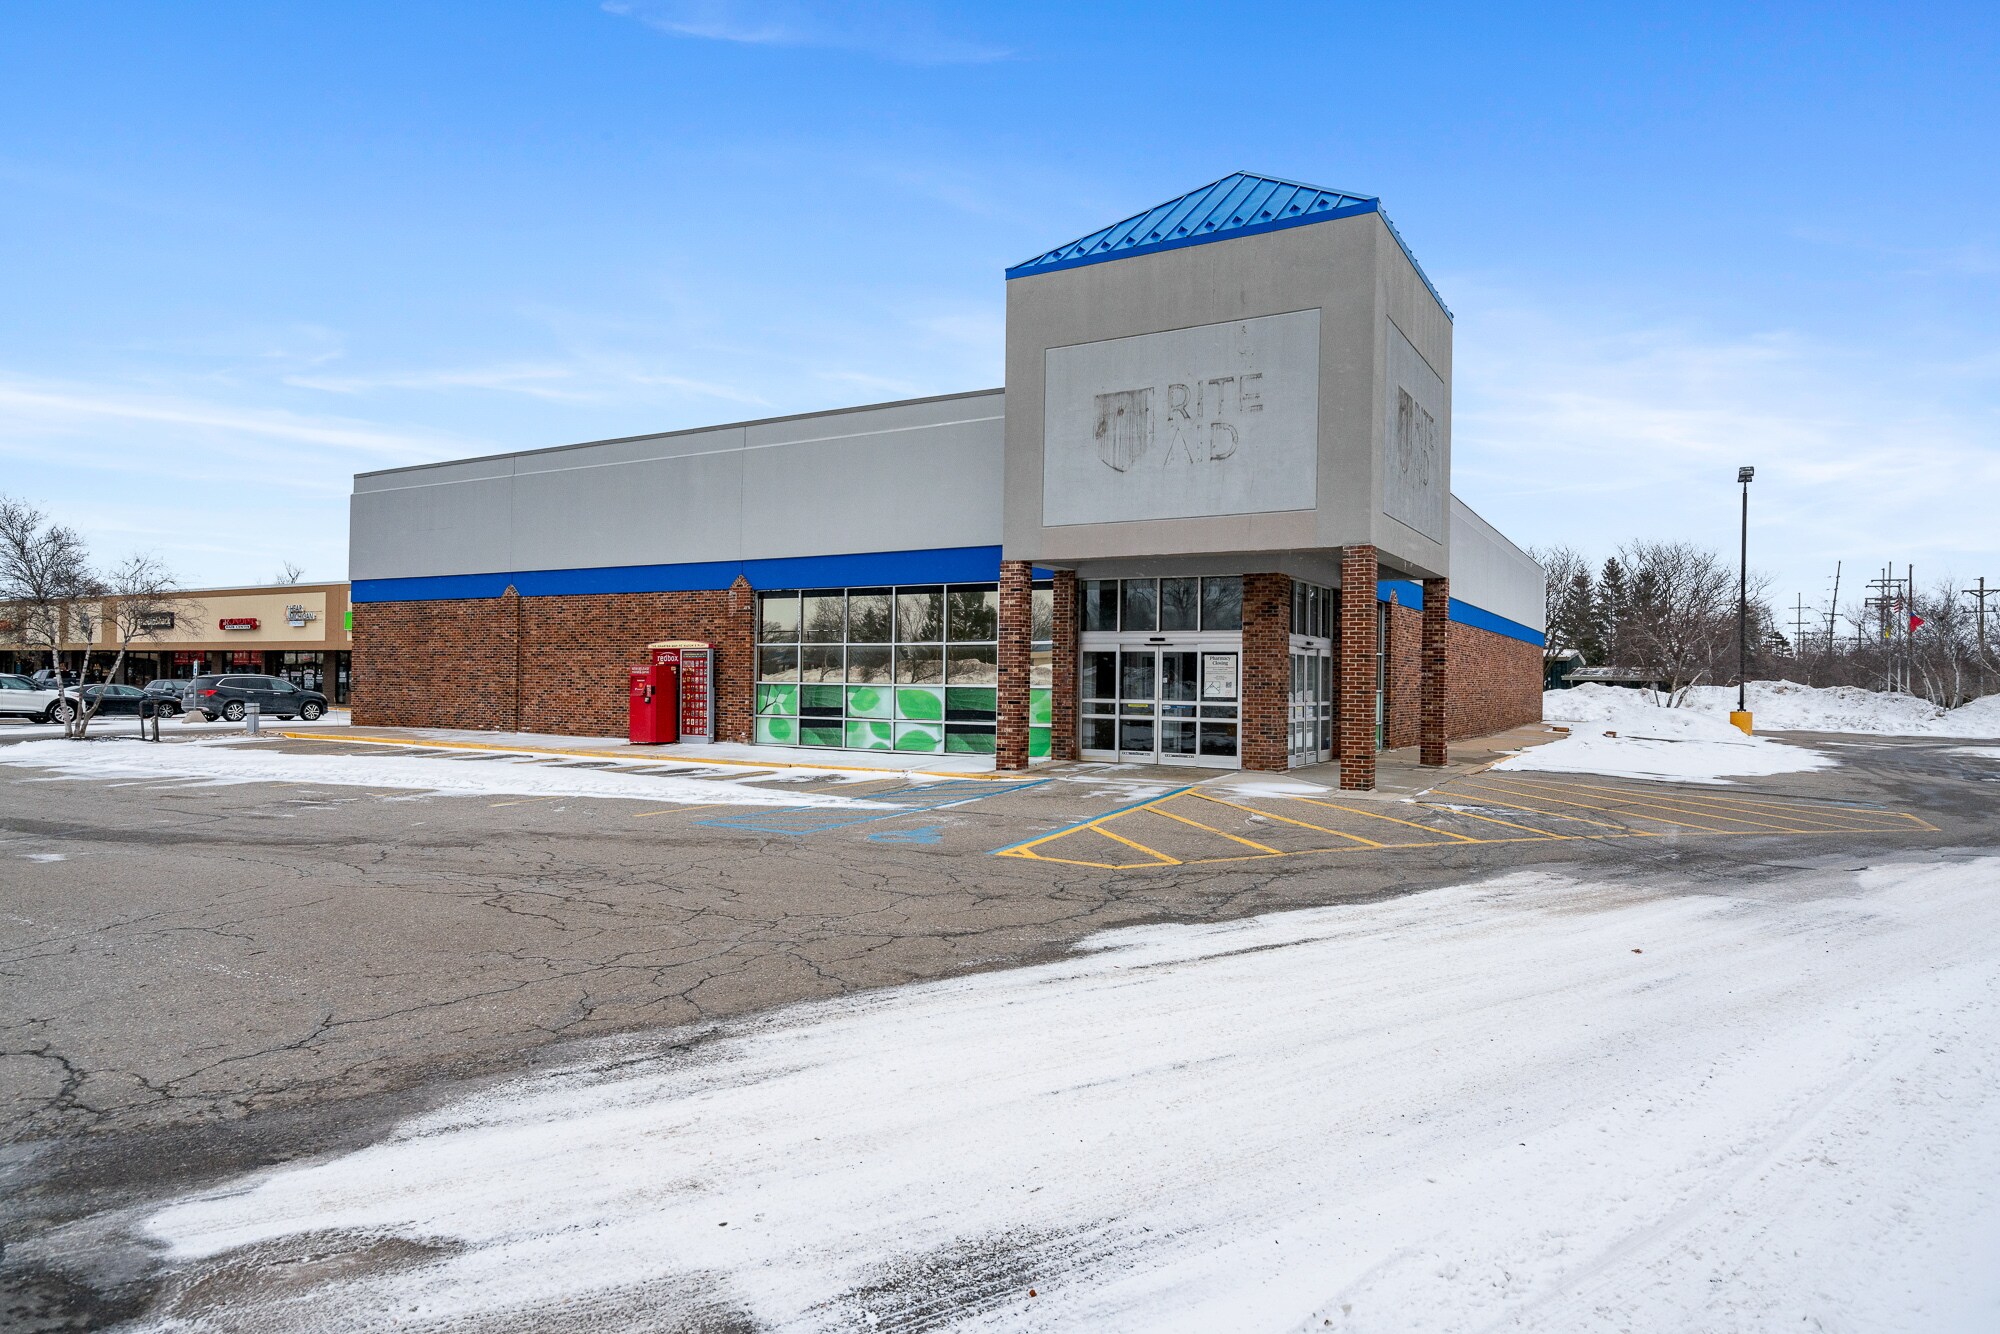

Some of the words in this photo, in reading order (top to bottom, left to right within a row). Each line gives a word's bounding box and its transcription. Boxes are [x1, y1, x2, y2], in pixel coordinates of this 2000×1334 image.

[1167, 373, 1263, 421] RITE
[1163, 422, 1239, 472] AID
[657, 654, 679, 662] redbox
